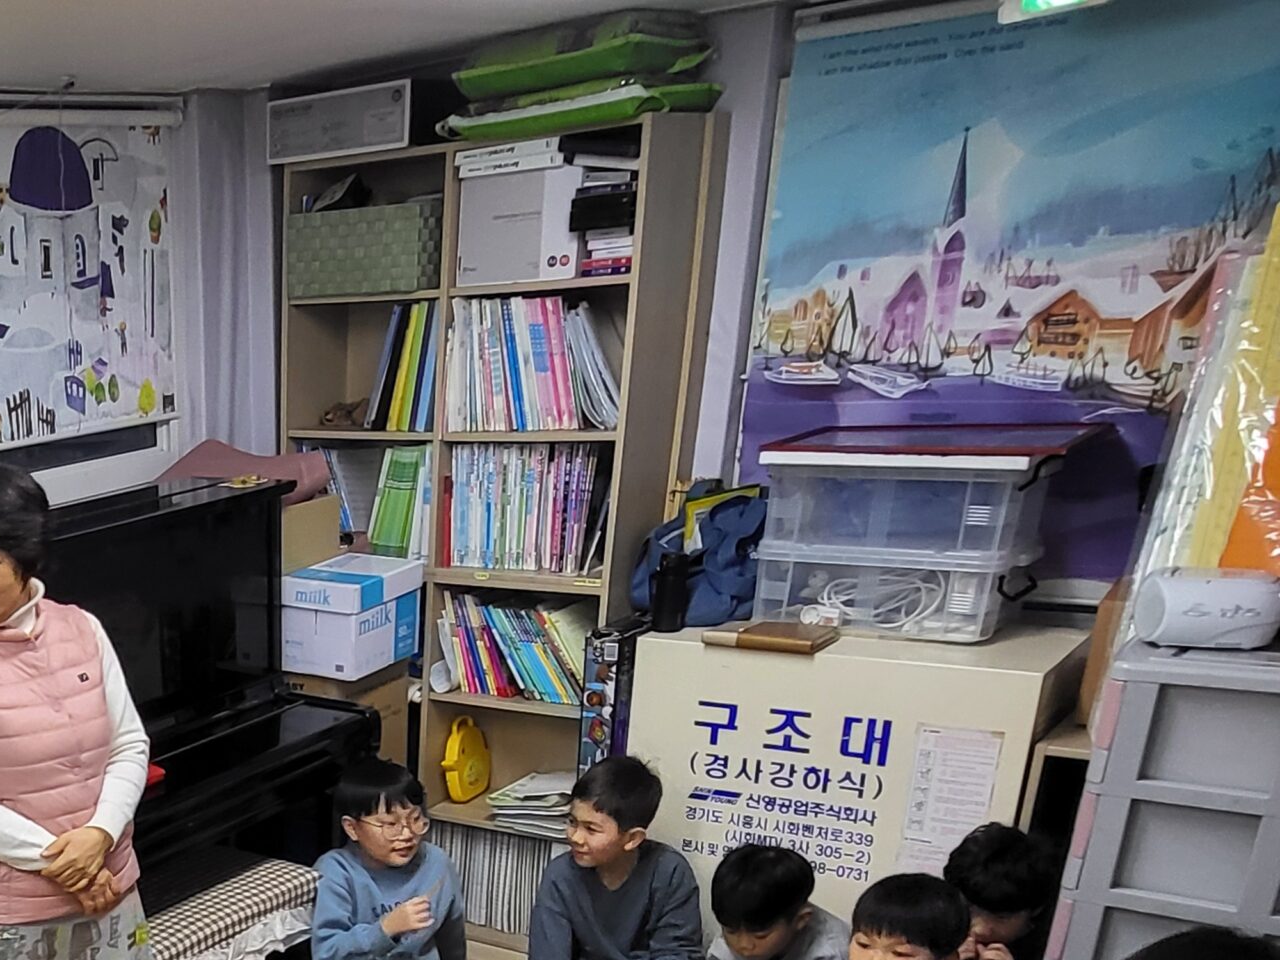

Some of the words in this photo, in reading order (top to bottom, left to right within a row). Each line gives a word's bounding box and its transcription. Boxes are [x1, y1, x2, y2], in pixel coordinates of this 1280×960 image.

[689, 752, 884, 800] (경사강하식)
[685, 805, 724, 824] 경기도
[727, 811, 769, 831] 시흥시
[745, 793, 878, 828] 신영공업주식회사
